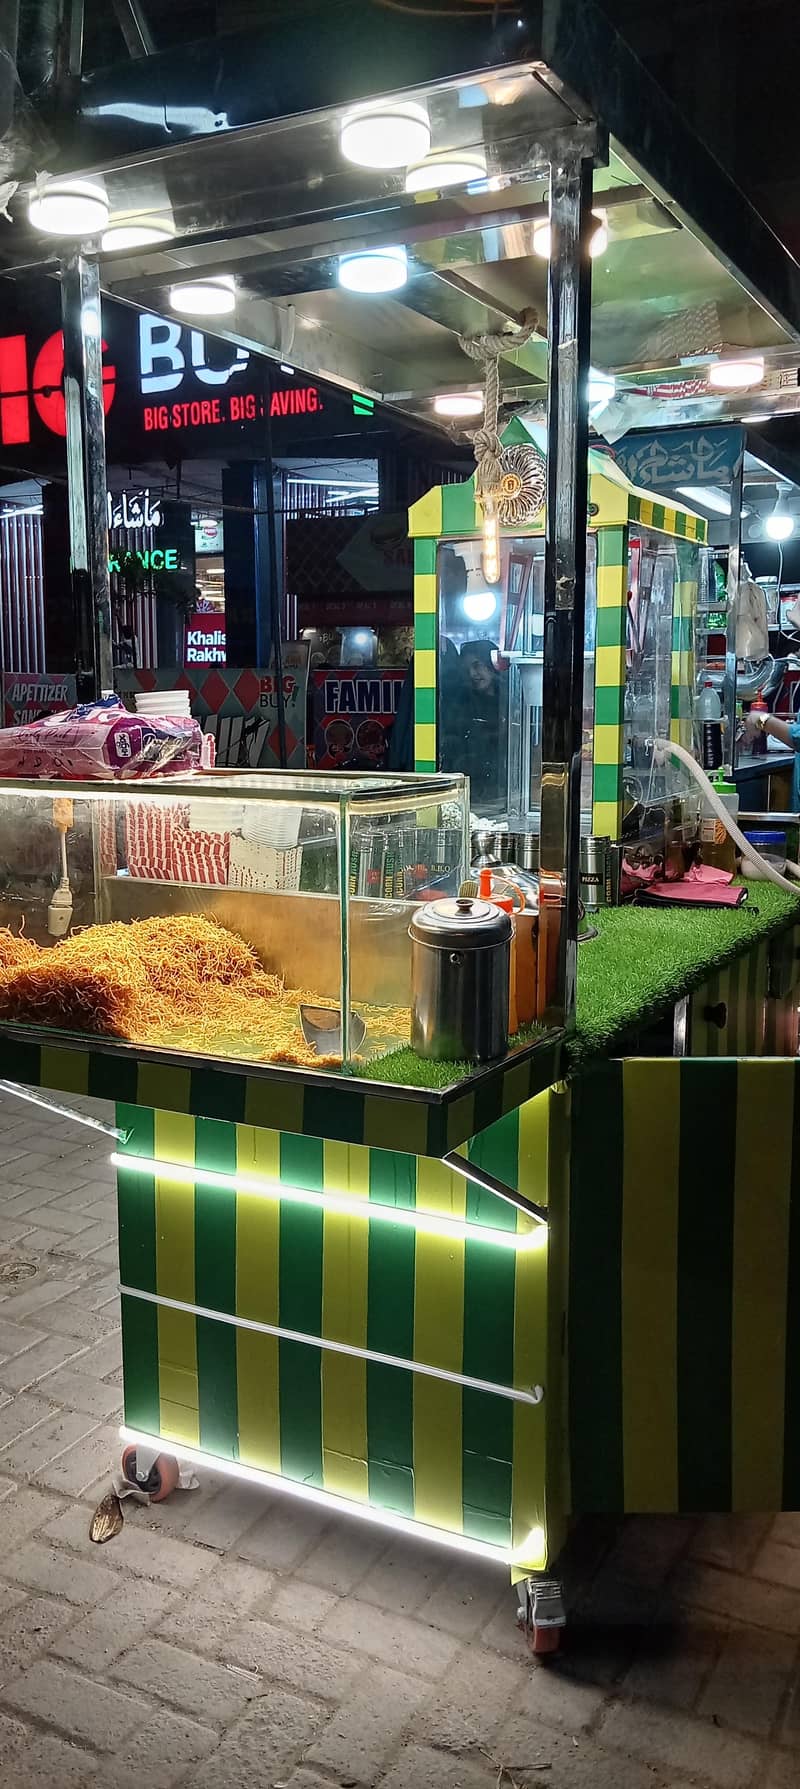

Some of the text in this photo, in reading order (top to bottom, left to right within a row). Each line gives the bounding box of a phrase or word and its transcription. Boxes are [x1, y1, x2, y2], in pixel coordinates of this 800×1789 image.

[143, 407, 169, 431] BIG
[172, 399, 226, 428] STORE.
[230, 394, 256, 420] BIG
[12, 683, 68, 702] APETTIZER
[260, 675, 293, 693] BIG
